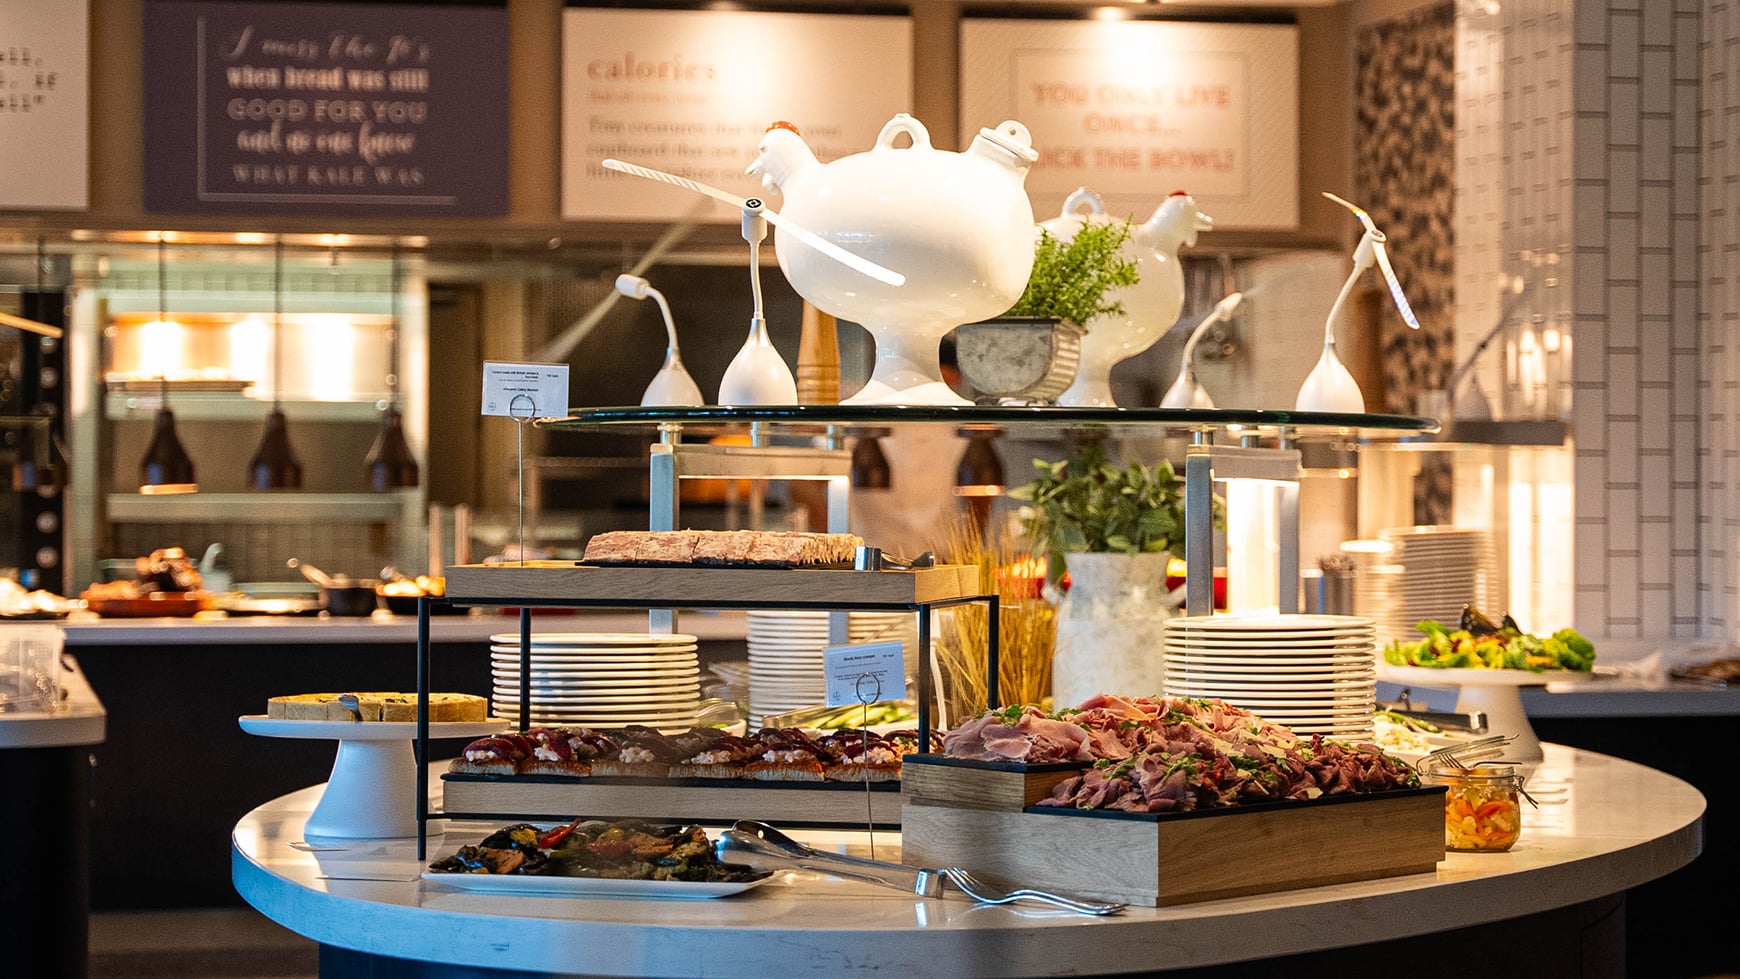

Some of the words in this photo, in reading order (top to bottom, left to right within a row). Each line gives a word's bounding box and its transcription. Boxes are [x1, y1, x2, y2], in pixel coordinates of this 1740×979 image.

[328, 31, 380, 60] the
[227, 65, 281, 91] when
[285, 65, 344, 92] bread
[346, 68, 386, 92] was
[388, 68, 430, 94] still
[587, 50, 718, 82] calories
[1032, 82, 1089, 106] YOU
[1174, 84, 1231, 108] LIVE
[227, 98, 308, 122] GOOD
[314, 99, 368, 123] FOR
[372, 101, 428, 124] YOU
[1094, 147, 1142, 171] THE
[1148, 147, 1236, 174] BOWL!
[233, 163, 300, 185] WHAT
[307, 165, 369, 187] KALE
[374, 166, 426, 188] WAS
